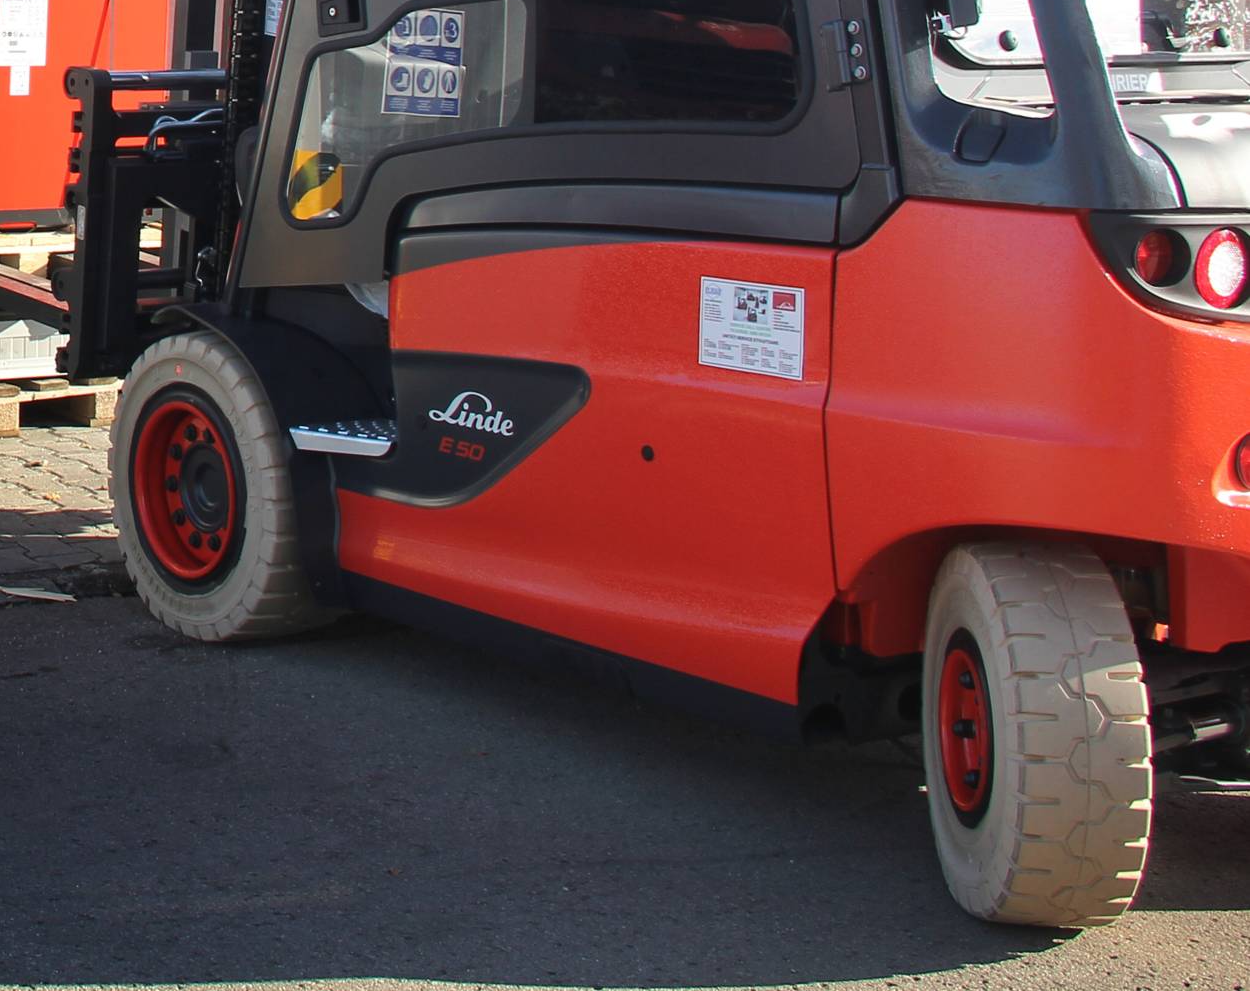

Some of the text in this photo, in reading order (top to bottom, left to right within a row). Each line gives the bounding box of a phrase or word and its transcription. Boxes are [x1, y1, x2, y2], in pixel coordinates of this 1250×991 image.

[429, 391, 514, 436] Linde
[438, 436, 486, 462] E 50
